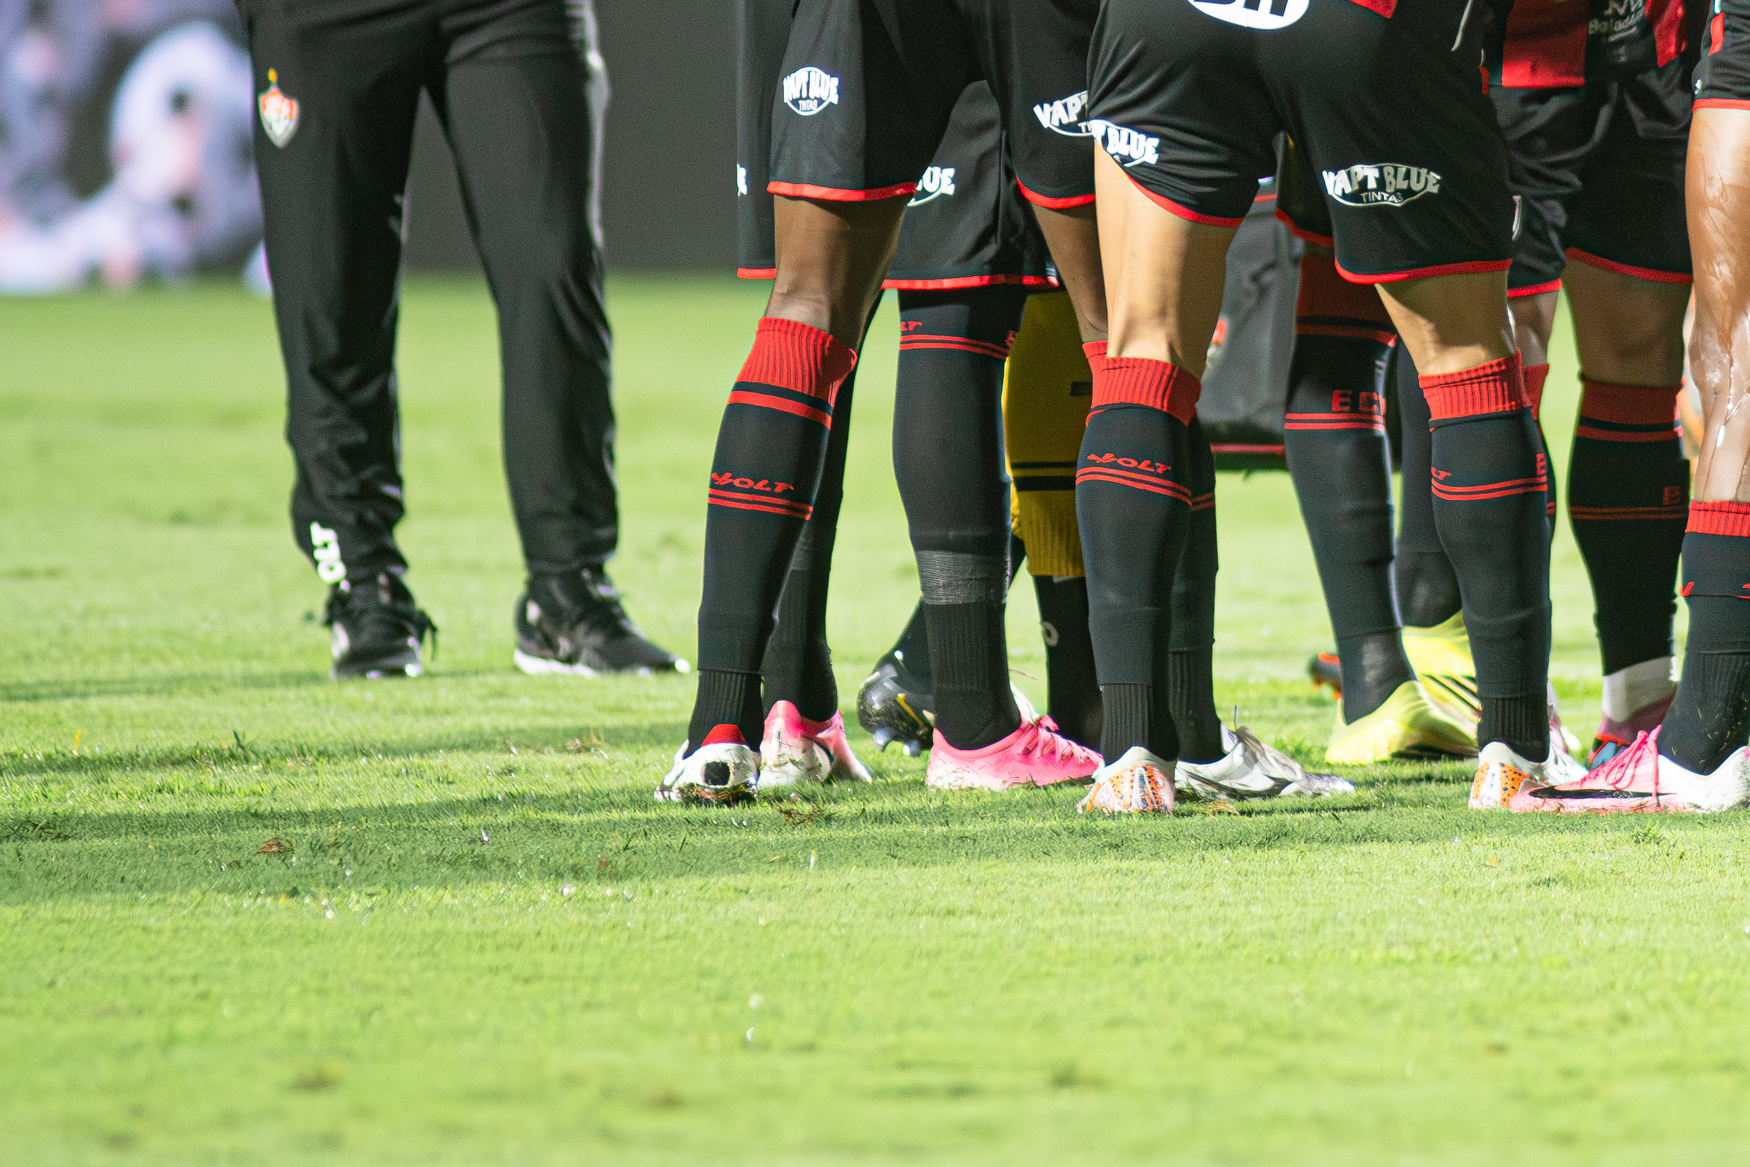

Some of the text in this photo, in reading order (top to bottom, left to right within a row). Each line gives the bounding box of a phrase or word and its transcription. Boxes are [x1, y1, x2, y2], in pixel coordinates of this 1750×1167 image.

[1107, 127, 1159, 165] BLUE
[1322, 165, 1441, 195] VAPT BLUE
[1360, 192, 1403, 203] TINTAS
[1087, 453, 1171, 474] VOLT
[711, 472, 794, 493] VOLT
